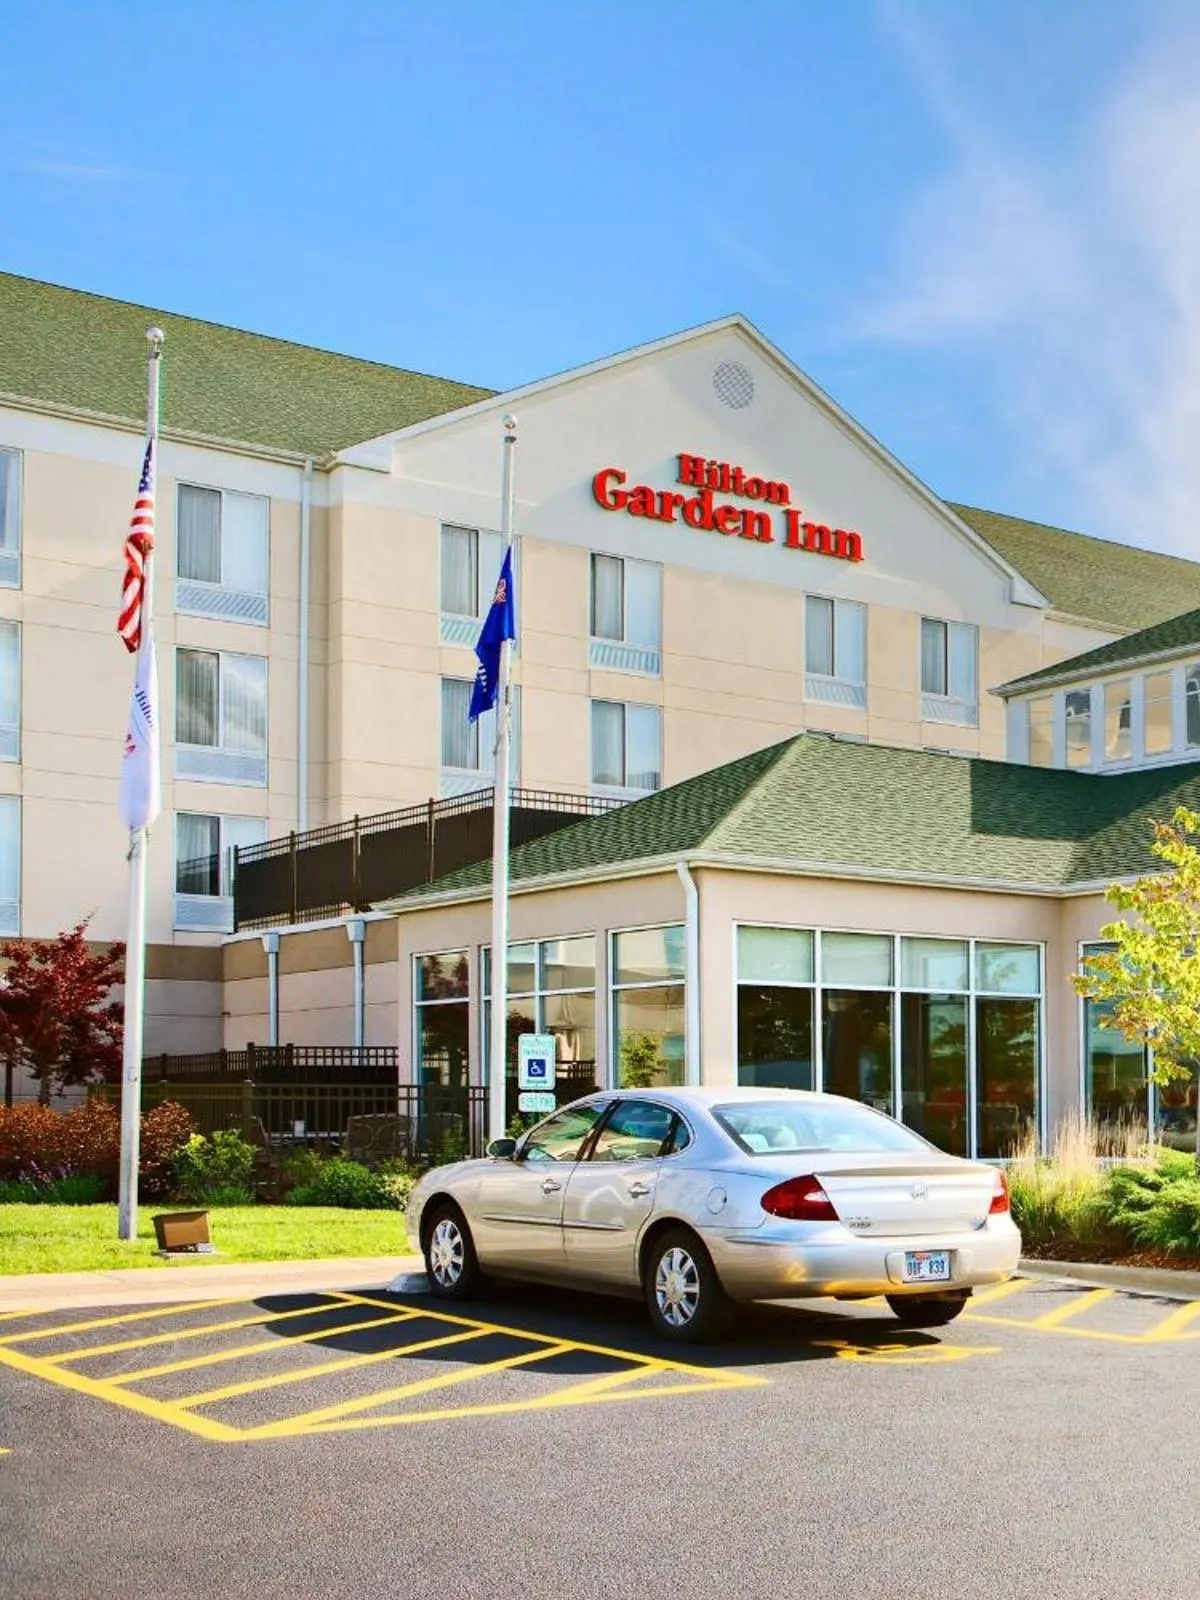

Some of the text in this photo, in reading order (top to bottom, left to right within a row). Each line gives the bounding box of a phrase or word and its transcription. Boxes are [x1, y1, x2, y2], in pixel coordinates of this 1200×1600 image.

[591, 467, 865, 563] Garden Inn
[677, 452, 792, 506] Hilton
